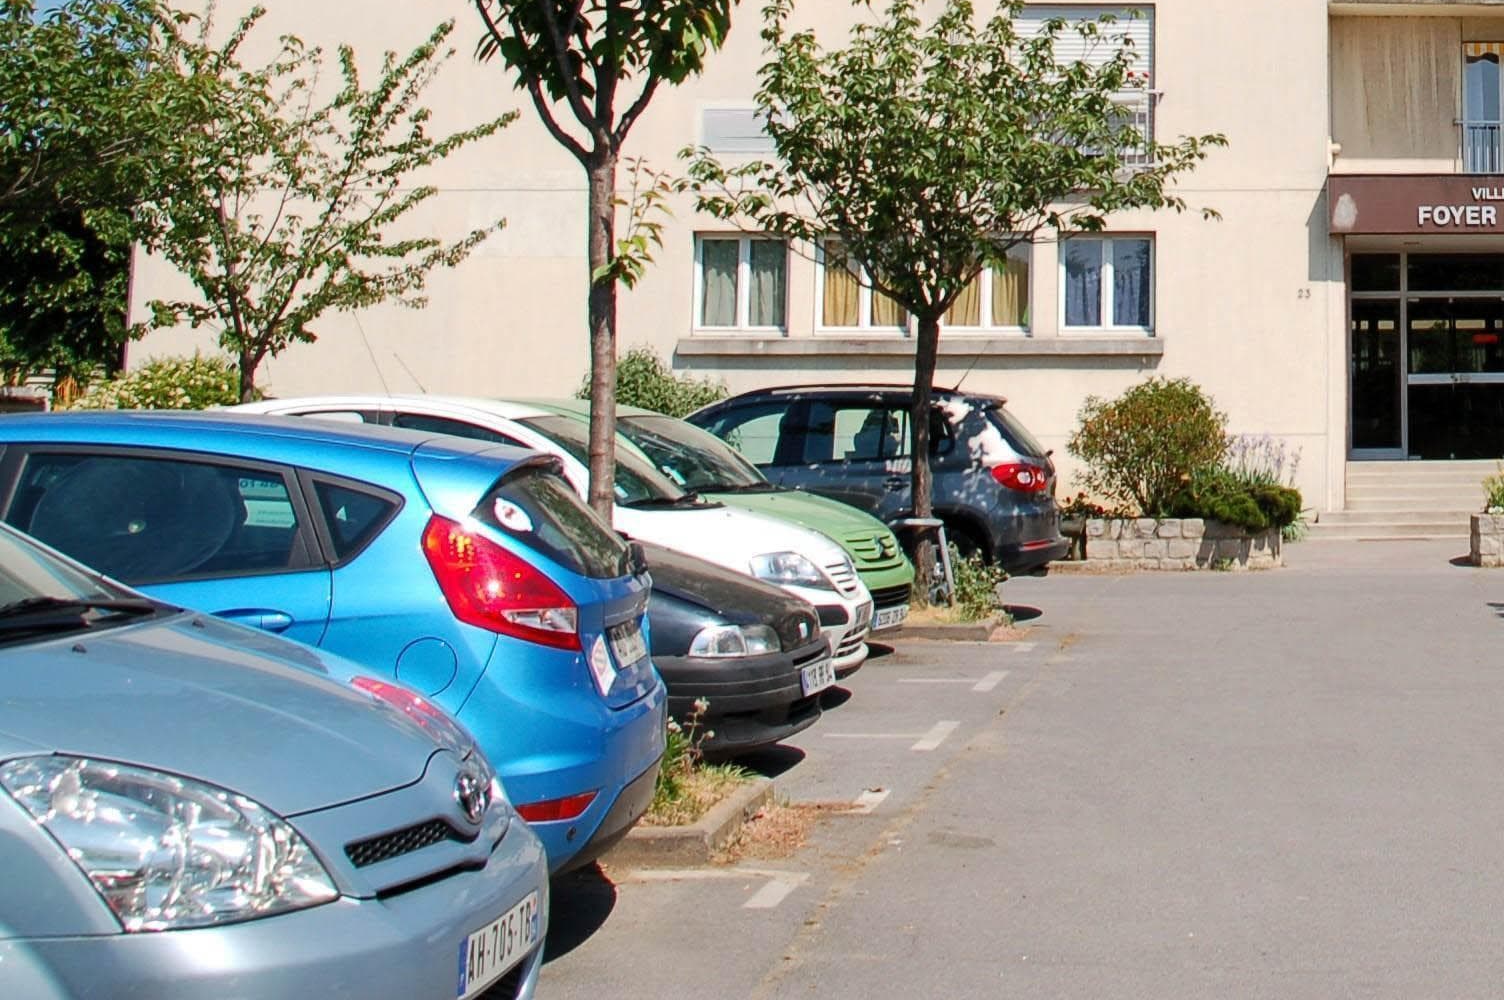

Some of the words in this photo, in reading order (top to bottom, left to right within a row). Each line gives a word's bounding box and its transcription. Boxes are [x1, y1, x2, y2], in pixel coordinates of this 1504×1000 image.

[1417, 205, 1497, 226] FOYER
[1297, 288, 1311, 300] 23
[468, 900, 531, 985] AH-705-TB
